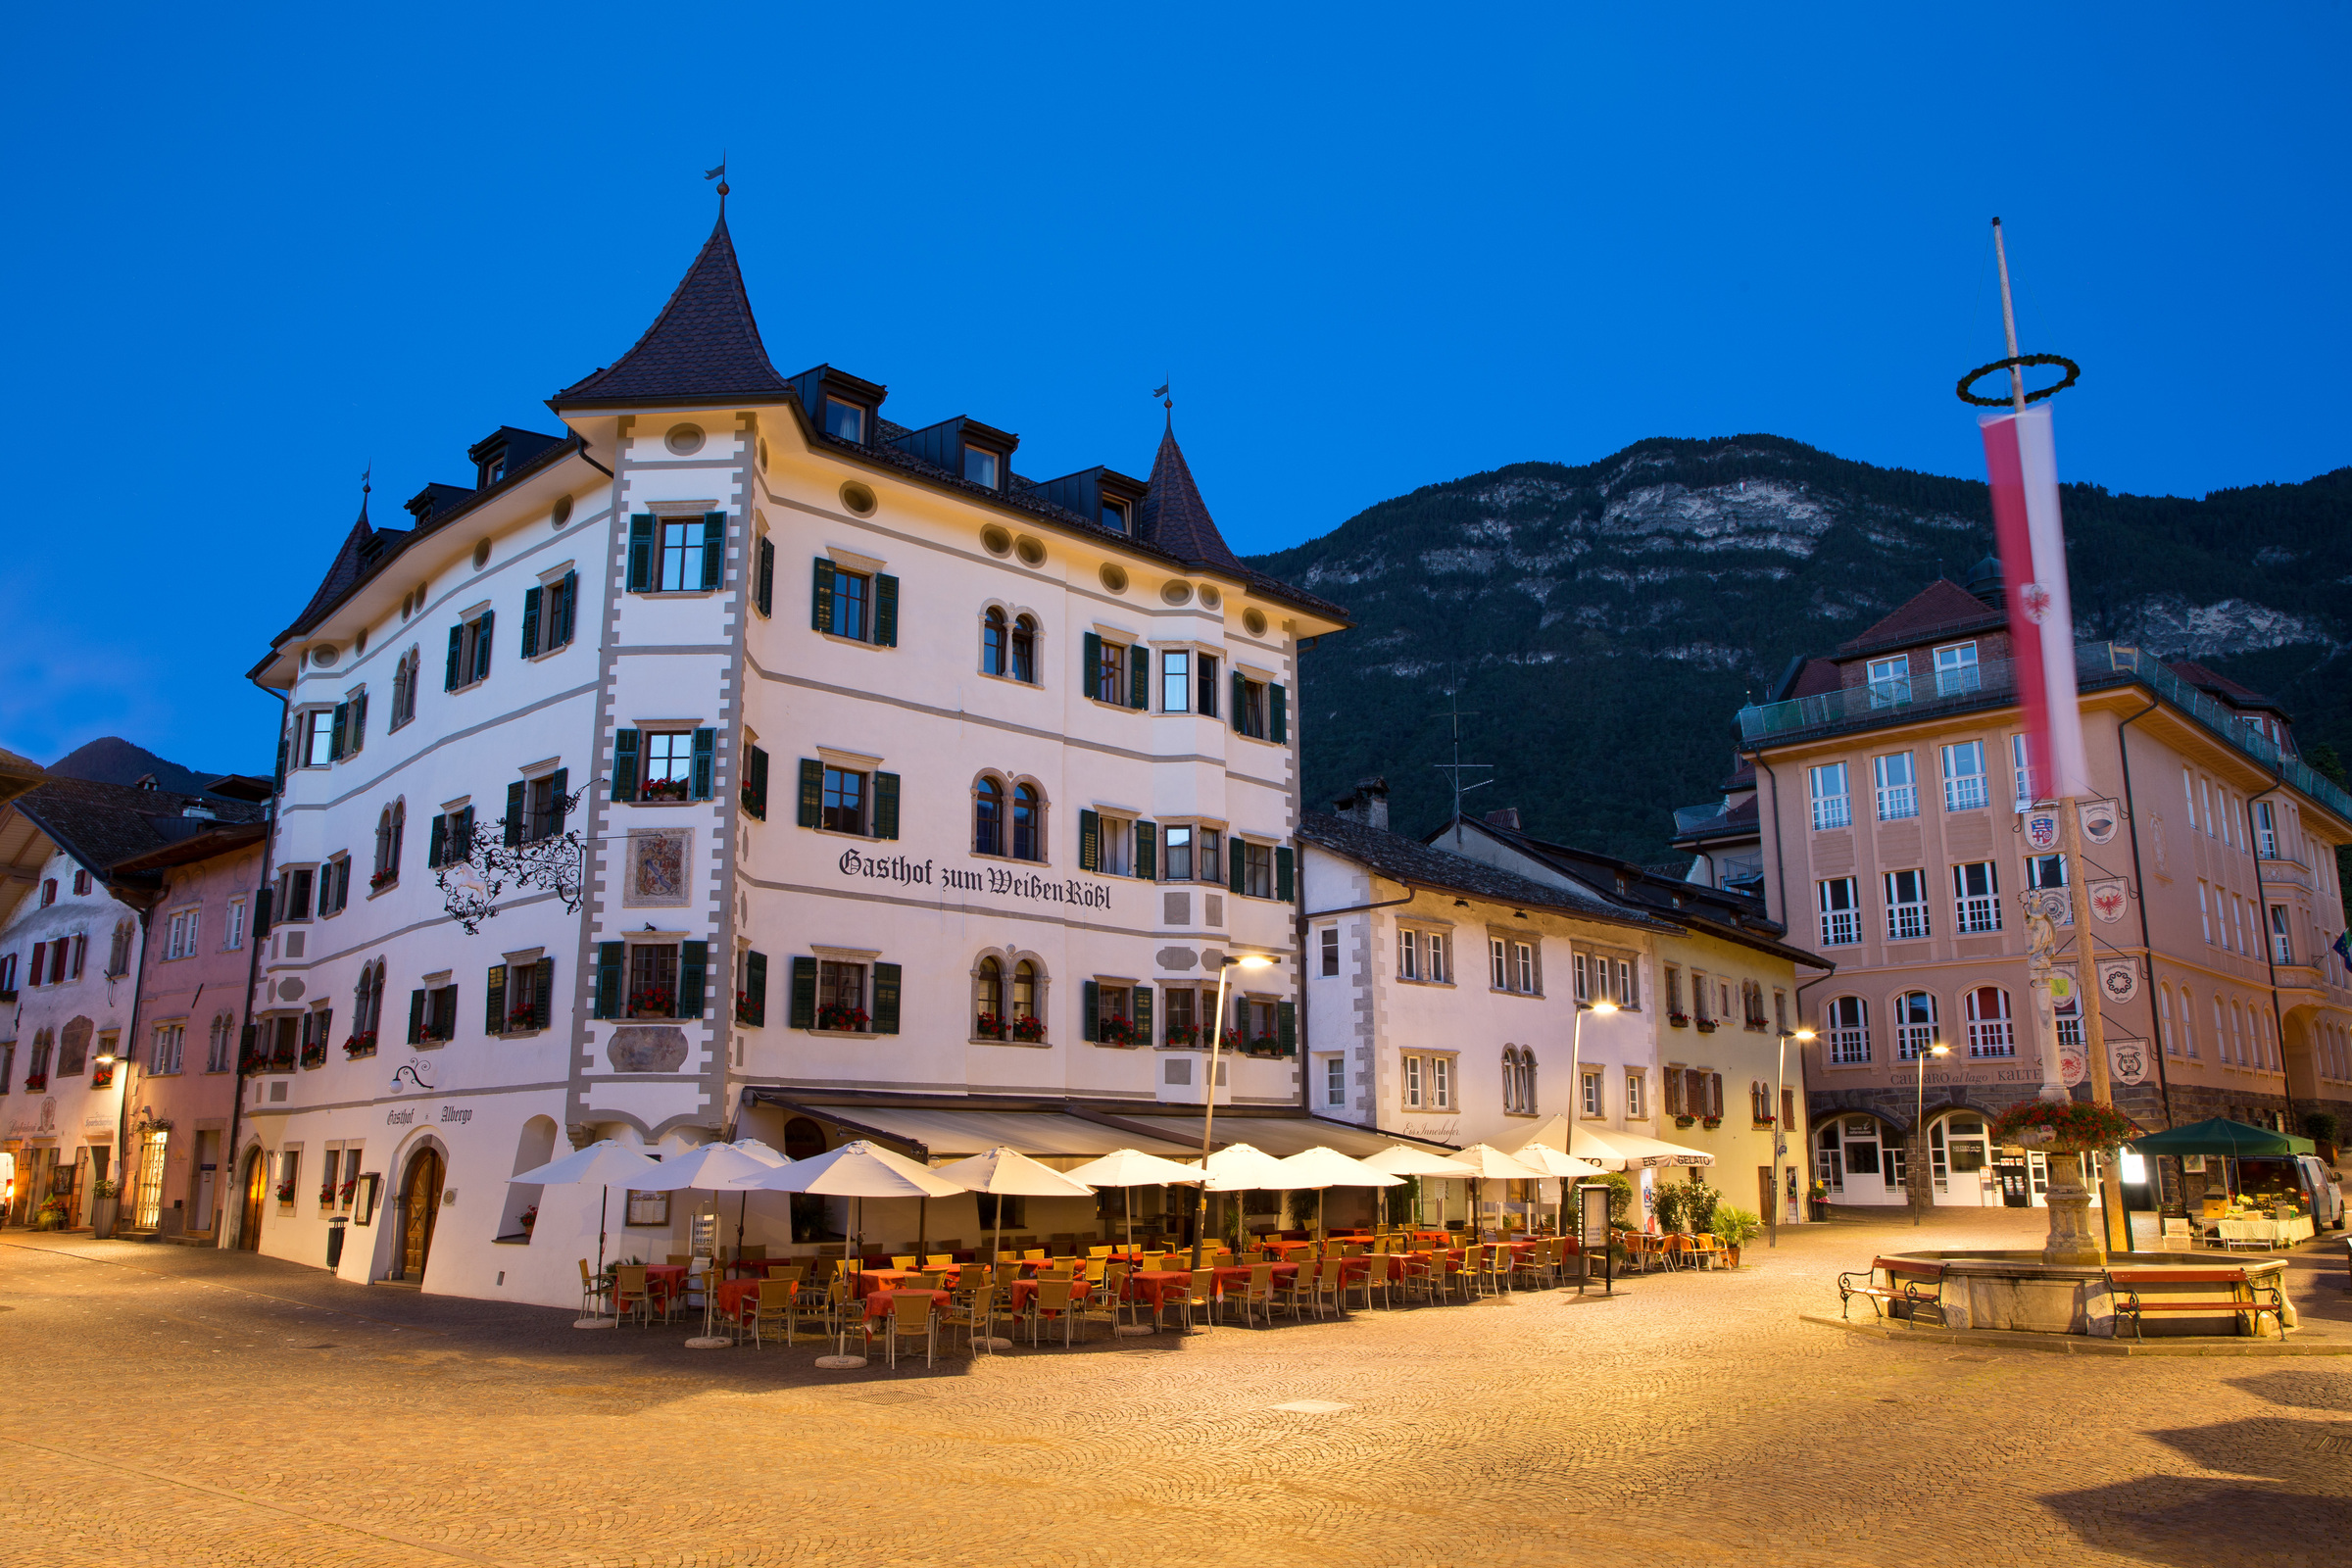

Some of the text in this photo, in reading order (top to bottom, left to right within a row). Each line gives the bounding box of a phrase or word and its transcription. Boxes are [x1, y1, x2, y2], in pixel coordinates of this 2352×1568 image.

[839, 848, 1111, 911] Gasthof zum Weißen Rößl
[1965, 1072, 1988, 1084] lago
[386, 1105, 472, 1127] Gasthof Albergo
[1402, 1121, 1416, 1136] Eis
[1642, 1155, 1710, 1167] EIS GELATO
